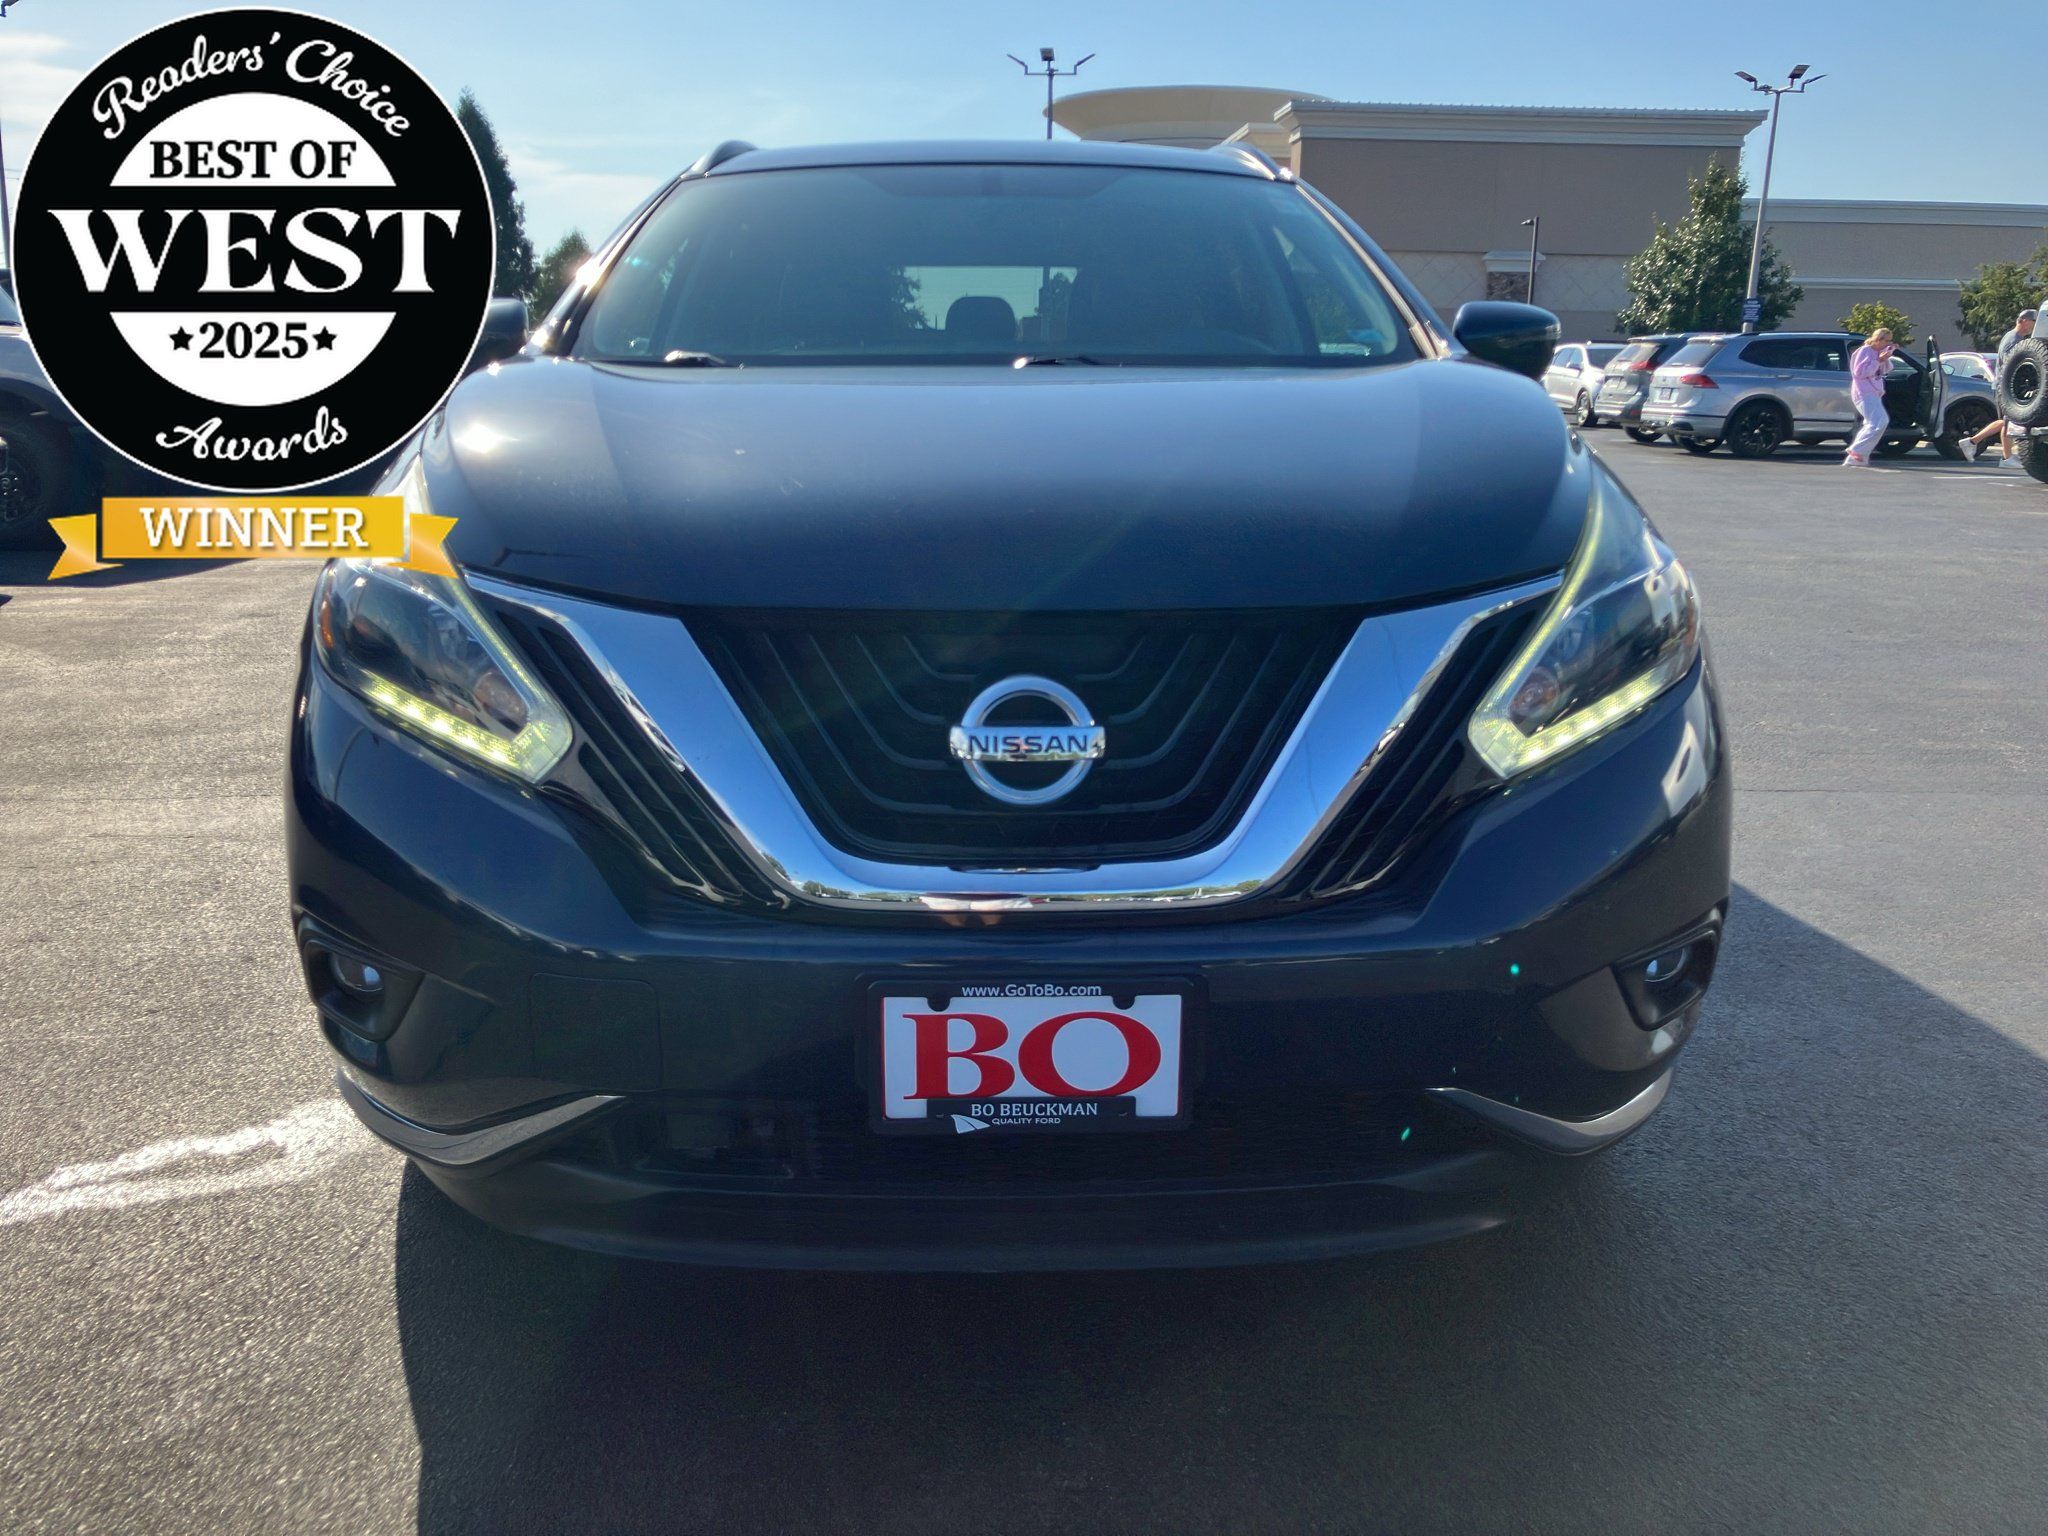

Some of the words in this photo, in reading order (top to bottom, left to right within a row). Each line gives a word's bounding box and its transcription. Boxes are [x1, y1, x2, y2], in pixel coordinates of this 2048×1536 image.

[968, 735, 1088, 754] NISSAN
[961, 983, 1102, 998] www.GoToBo.com
[902, 1011, 1162, 1100] BO
[971, 1103, 994, 1117] BO
[1000, 1102, 1099, 1117] BEUCKMAN
[991, 1117, 1033, 1125] QUALITY
[1035, 1117, 1061, 1125] FORD
